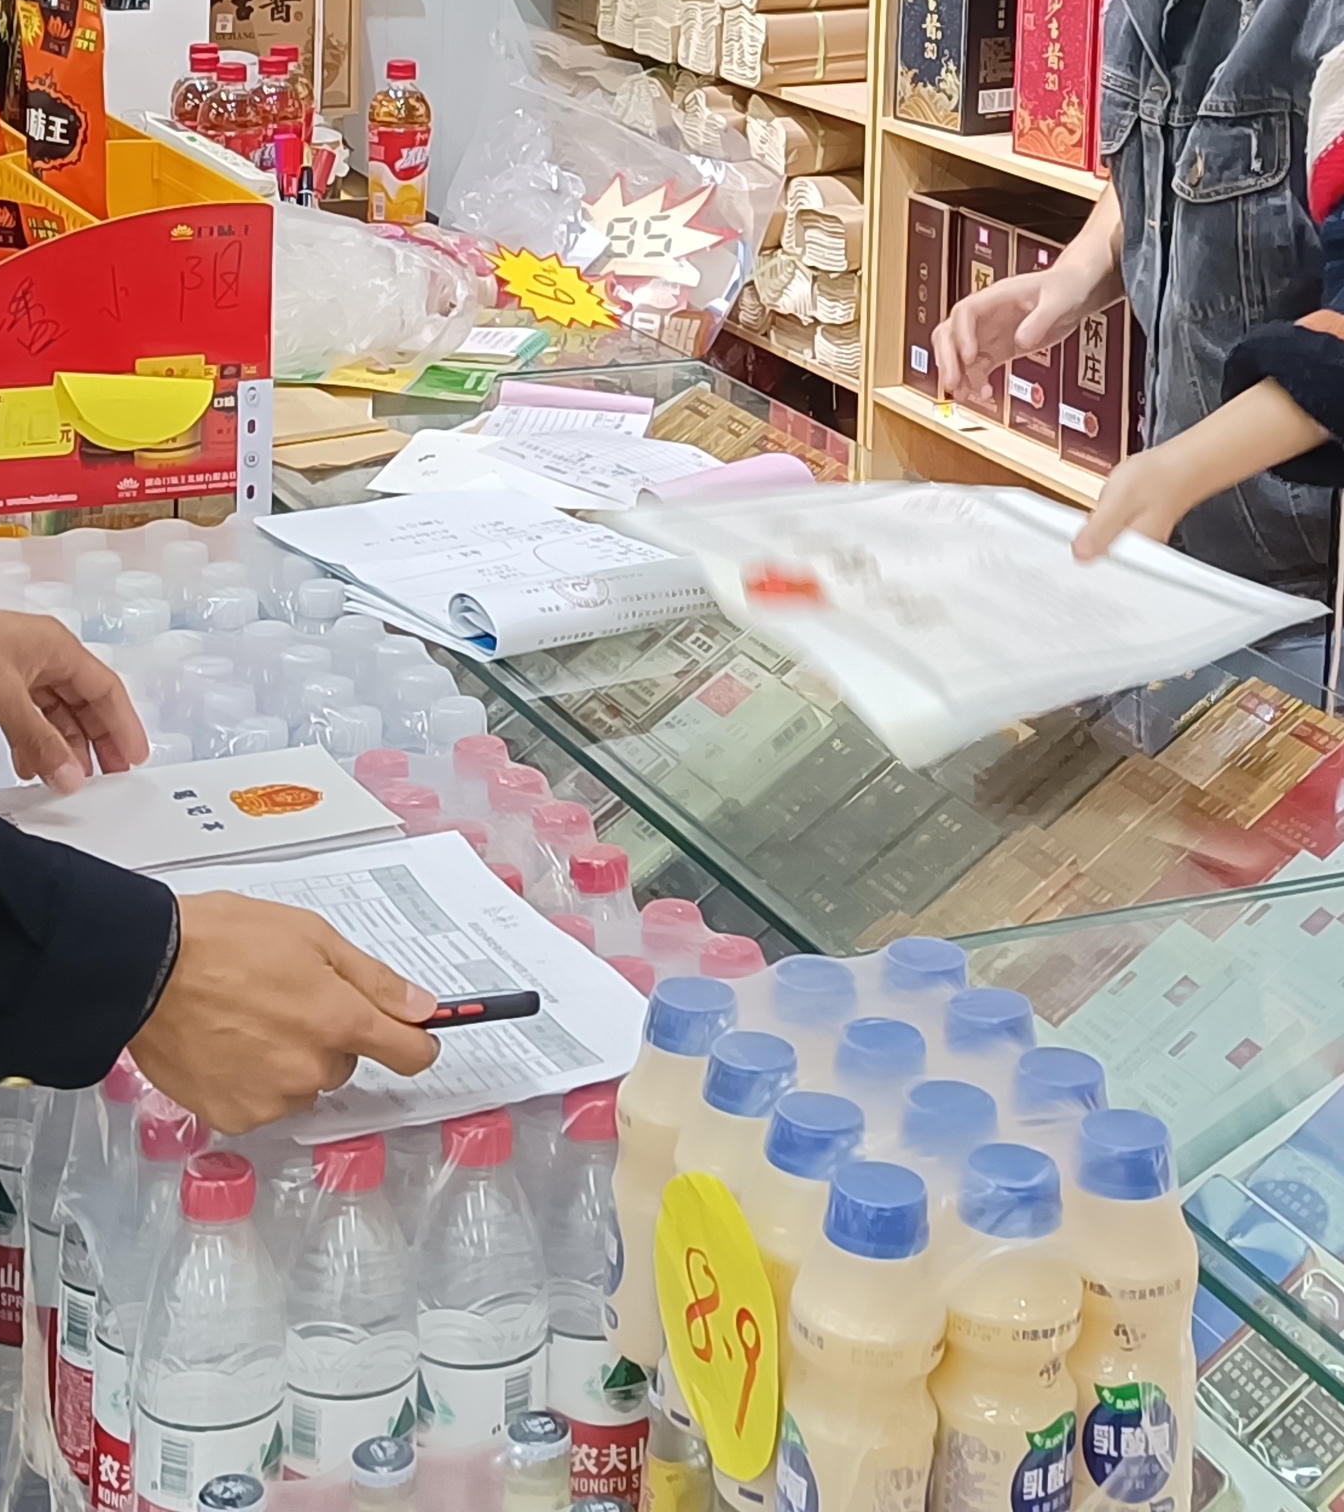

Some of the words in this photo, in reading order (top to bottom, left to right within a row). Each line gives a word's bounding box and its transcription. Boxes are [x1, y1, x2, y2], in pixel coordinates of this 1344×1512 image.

[1082, 313, 1105, 387] 怀庄
[59, 423, 73, 445] 元
[684, 1246, 762, 1440] 8.9
